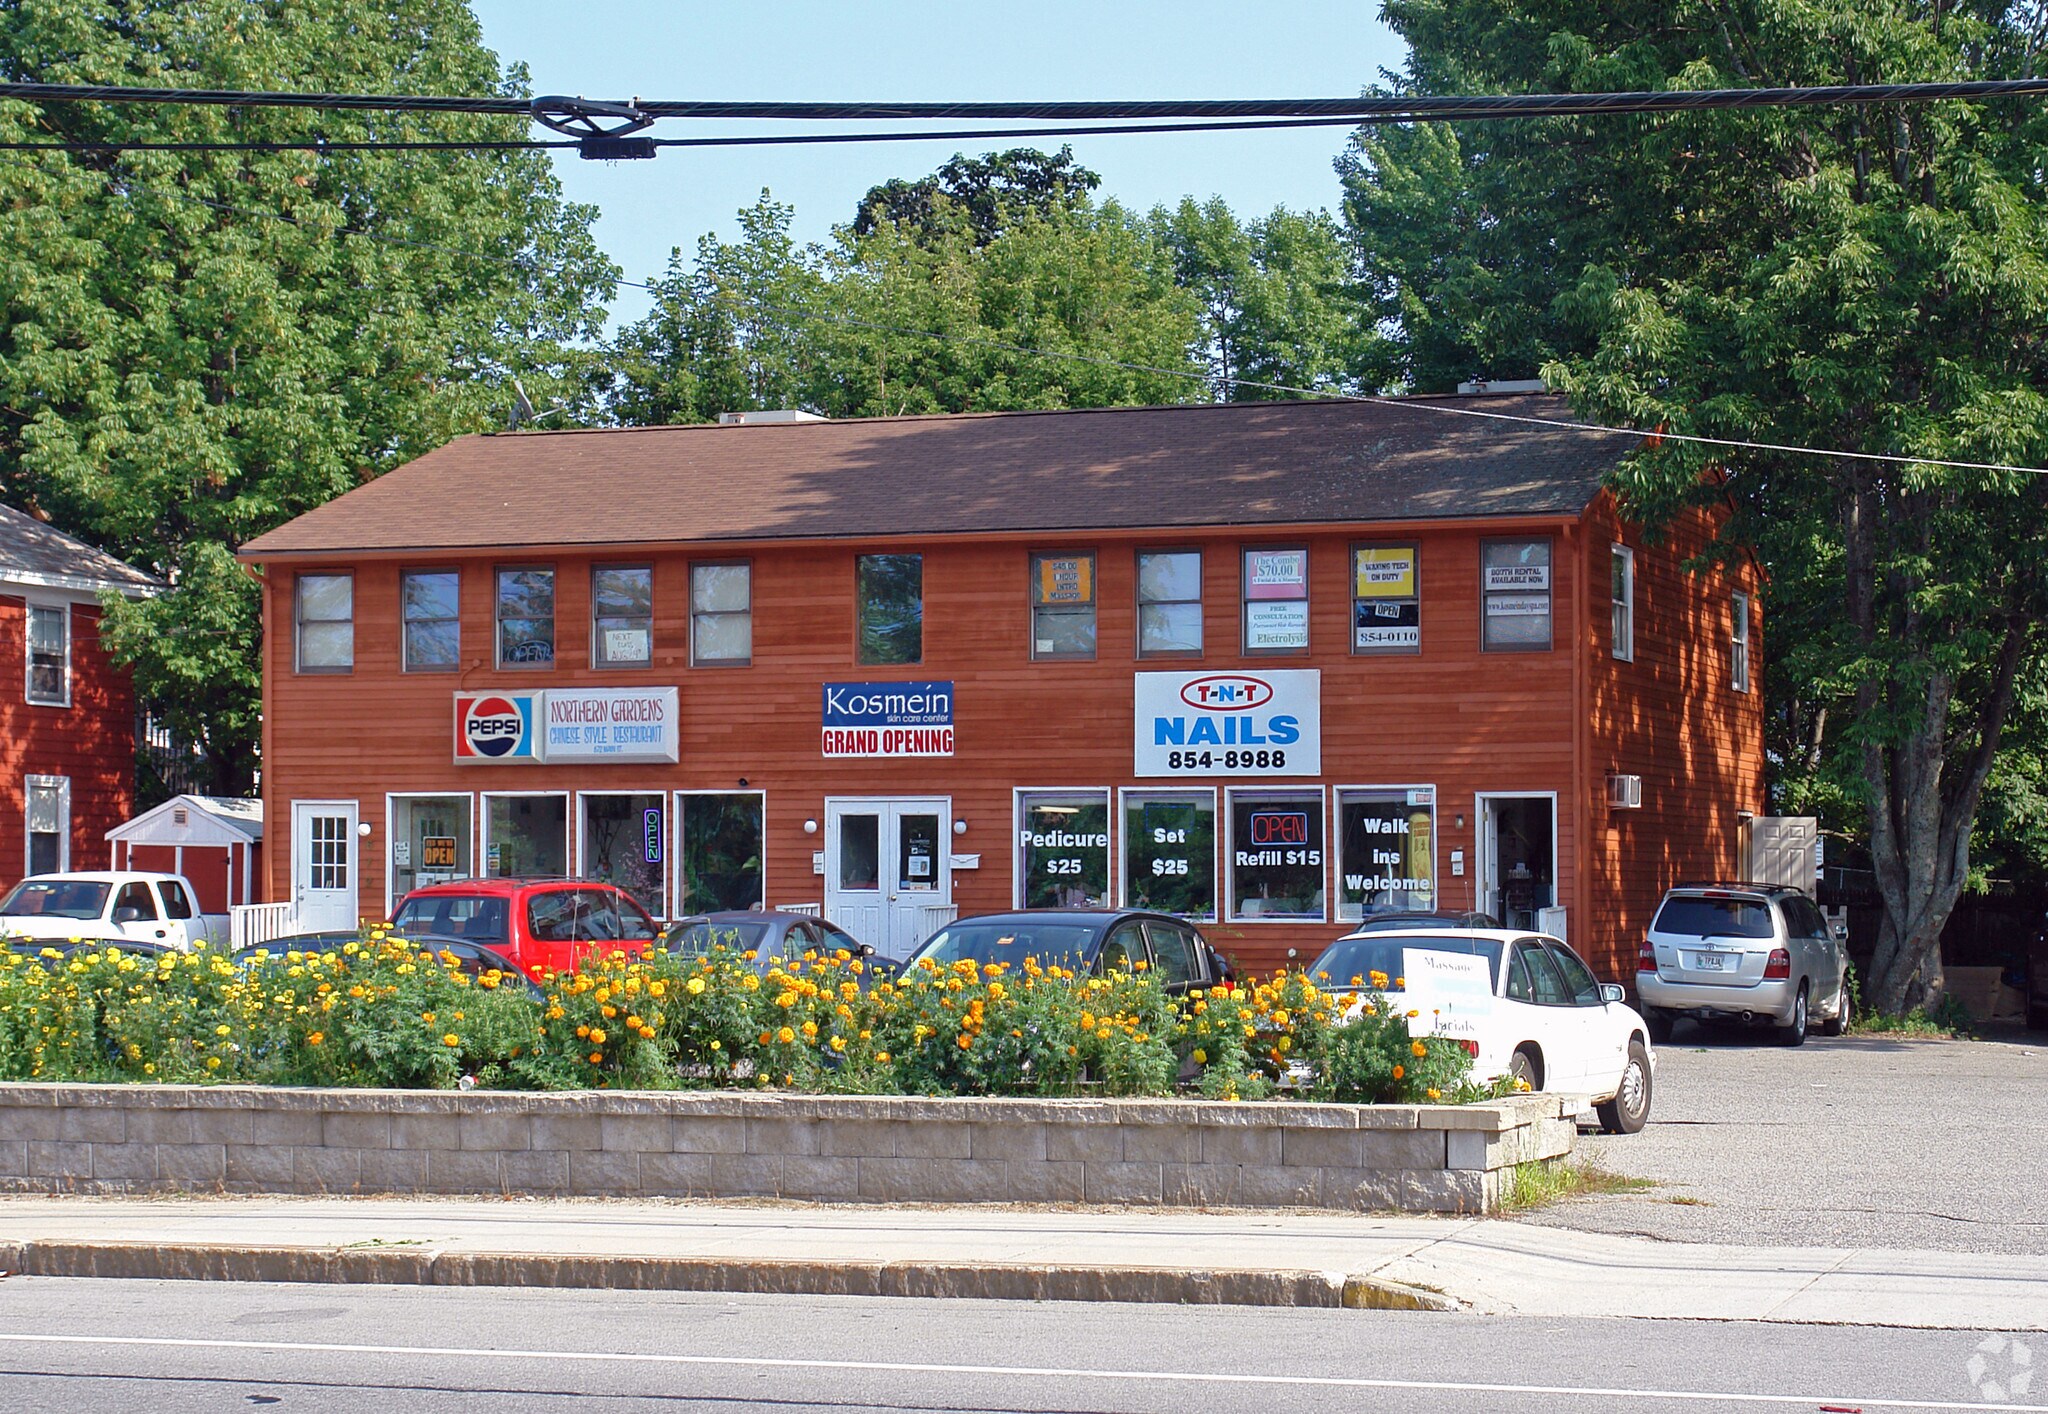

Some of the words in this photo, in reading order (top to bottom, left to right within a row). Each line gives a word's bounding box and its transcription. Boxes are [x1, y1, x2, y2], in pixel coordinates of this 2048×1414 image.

[1256, 557, 1270, 566] The
[1272, 556, 1300, 566] Combo
[1366, 562, 1391, 571] WAXING
[1392, 561, 1410, 570] TECH
[1258, 565, 1293, 577] $70.00
[1371, 573, 1380, 581] ON
[1382, 573, 1400, 581] DUTY
[1491, 568, 1513, 576] BOOTH
[1491, 576, 1527, 584] AVAILABLE
[1528, 575, 1544, 583] NOW
[1377, 604, 1399, 616] OPEN
[1360, 632, 1417, 643] 854-0110
[507, 645, 546, 662] OPEN
[827, 684, 948, 715] Kosmein
[1198, 685, 1257, 702] T-N-T
[551, 699, 608, 723] NORTHERN
[611, 698, 664, 723] GARDENS
[886, 714, 901, 723] skin
[903, 715, 921, 723] care
[922, 714, 949, 723] center
[468, 719, 521, 735] PEPSI
[549, 726, 581, 744] CHINESE
[584, 726, 607, 744] STYLE
[613, 725, 663, 743] RESTAURANT
[1154, 715, 1300, 745] NAILS
[823, 730, 879, 754] GRAND
[882, 729, 953, 754] OPENING
[1168, 750, 1286, 769] 854-8988
[1254, 815, 1305, 841] OPEN
[1363, 818, 1410, 834] Walk
[647, 812, 658, 859] OPEN
[1020, 830, 1108, 848] Pedicure
[1154, 827, 1186, 844] Set
[425, 847, 454, 865] OPEN
[1235, 850, 1282, 867] Refill
[1286, 850, 1321, 866] $15
[1372, 848, 1400, 865] ins
[1047, 858, 1082, 875] $25
[1152, 857, 1189, 876] $25
[1345, 875, 1431, 891] Welcome
